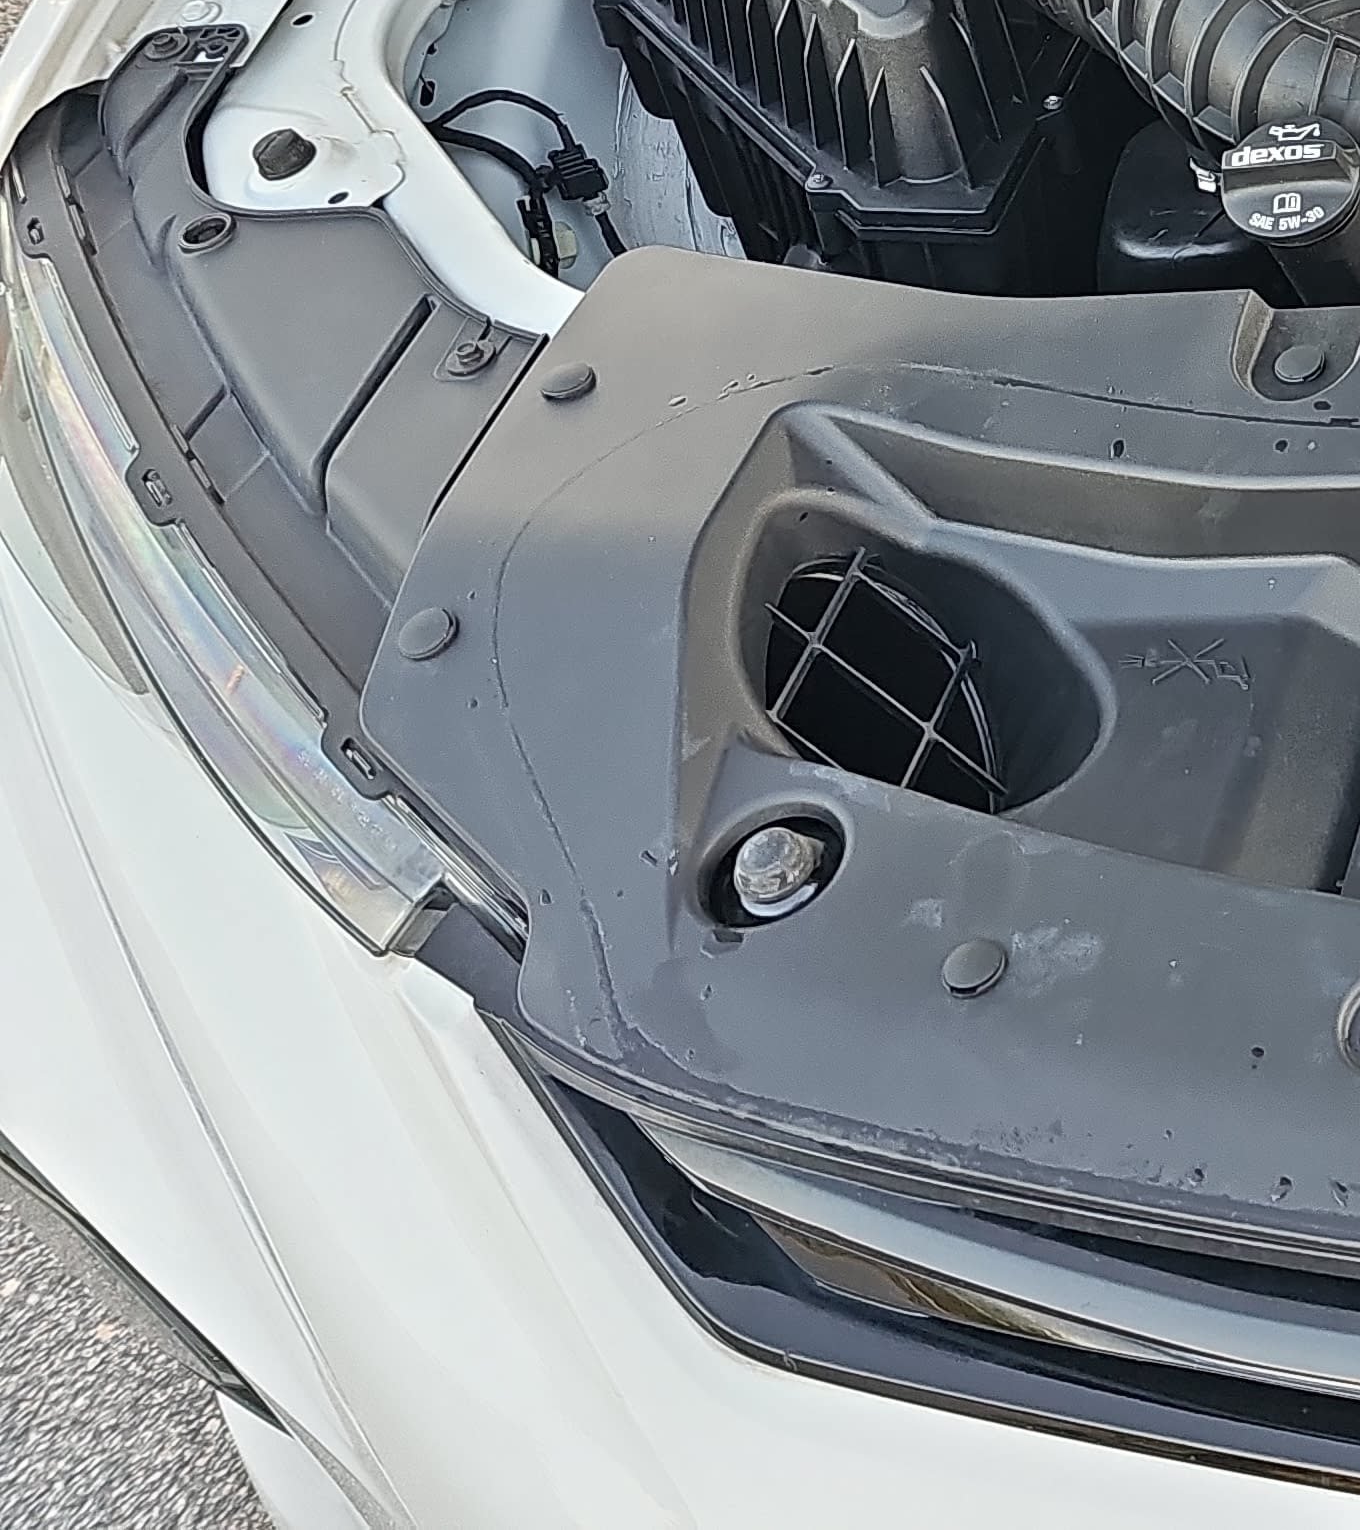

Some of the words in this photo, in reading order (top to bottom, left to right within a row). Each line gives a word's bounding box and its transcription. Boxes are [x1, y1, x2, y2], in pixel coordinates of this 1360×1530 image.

[1231, 143, 1325, 167] dexos
[1248, 212, 1275, 231] SAE
[1278, 206, 1325, 231] 5W-30
